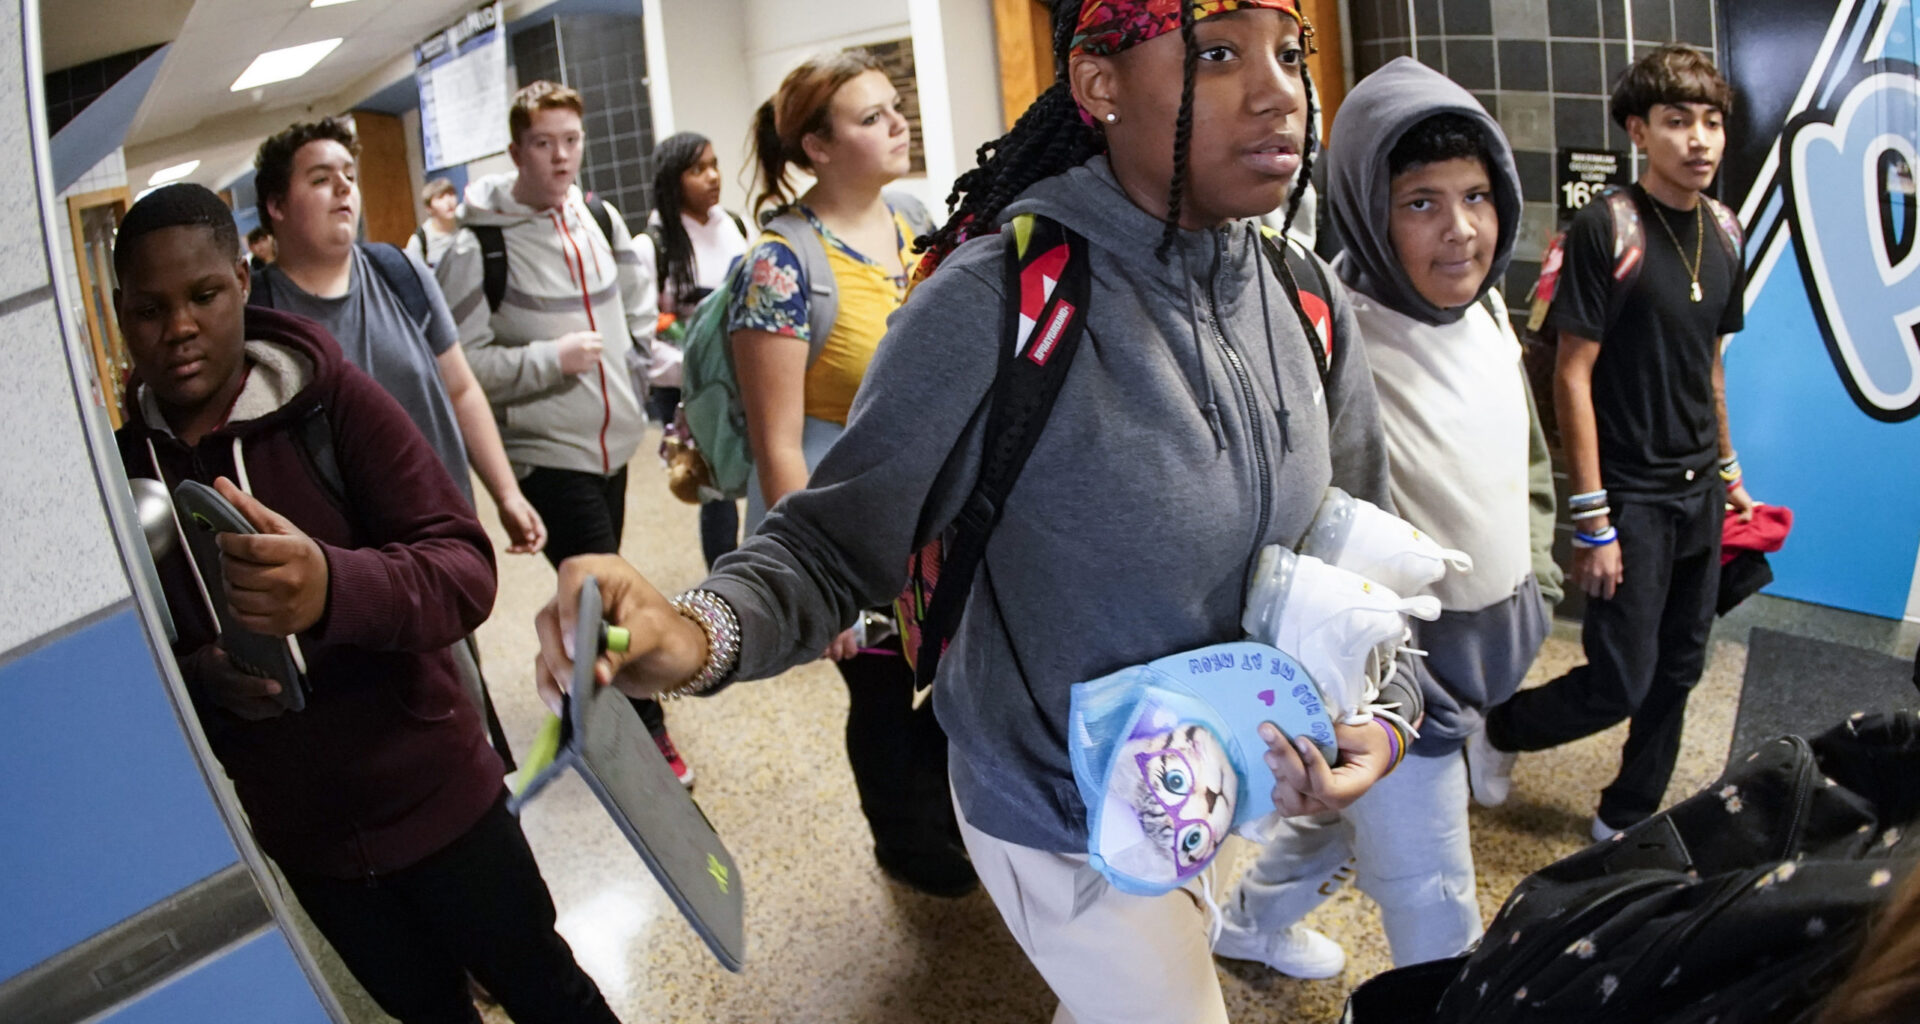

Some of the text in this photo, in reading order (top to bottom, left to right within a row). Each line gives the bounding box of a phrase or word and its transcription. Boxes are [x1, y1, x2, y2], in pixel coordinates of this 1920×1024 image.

[1189, 653, 1334, 745] OU HAD ME AT MEOW
